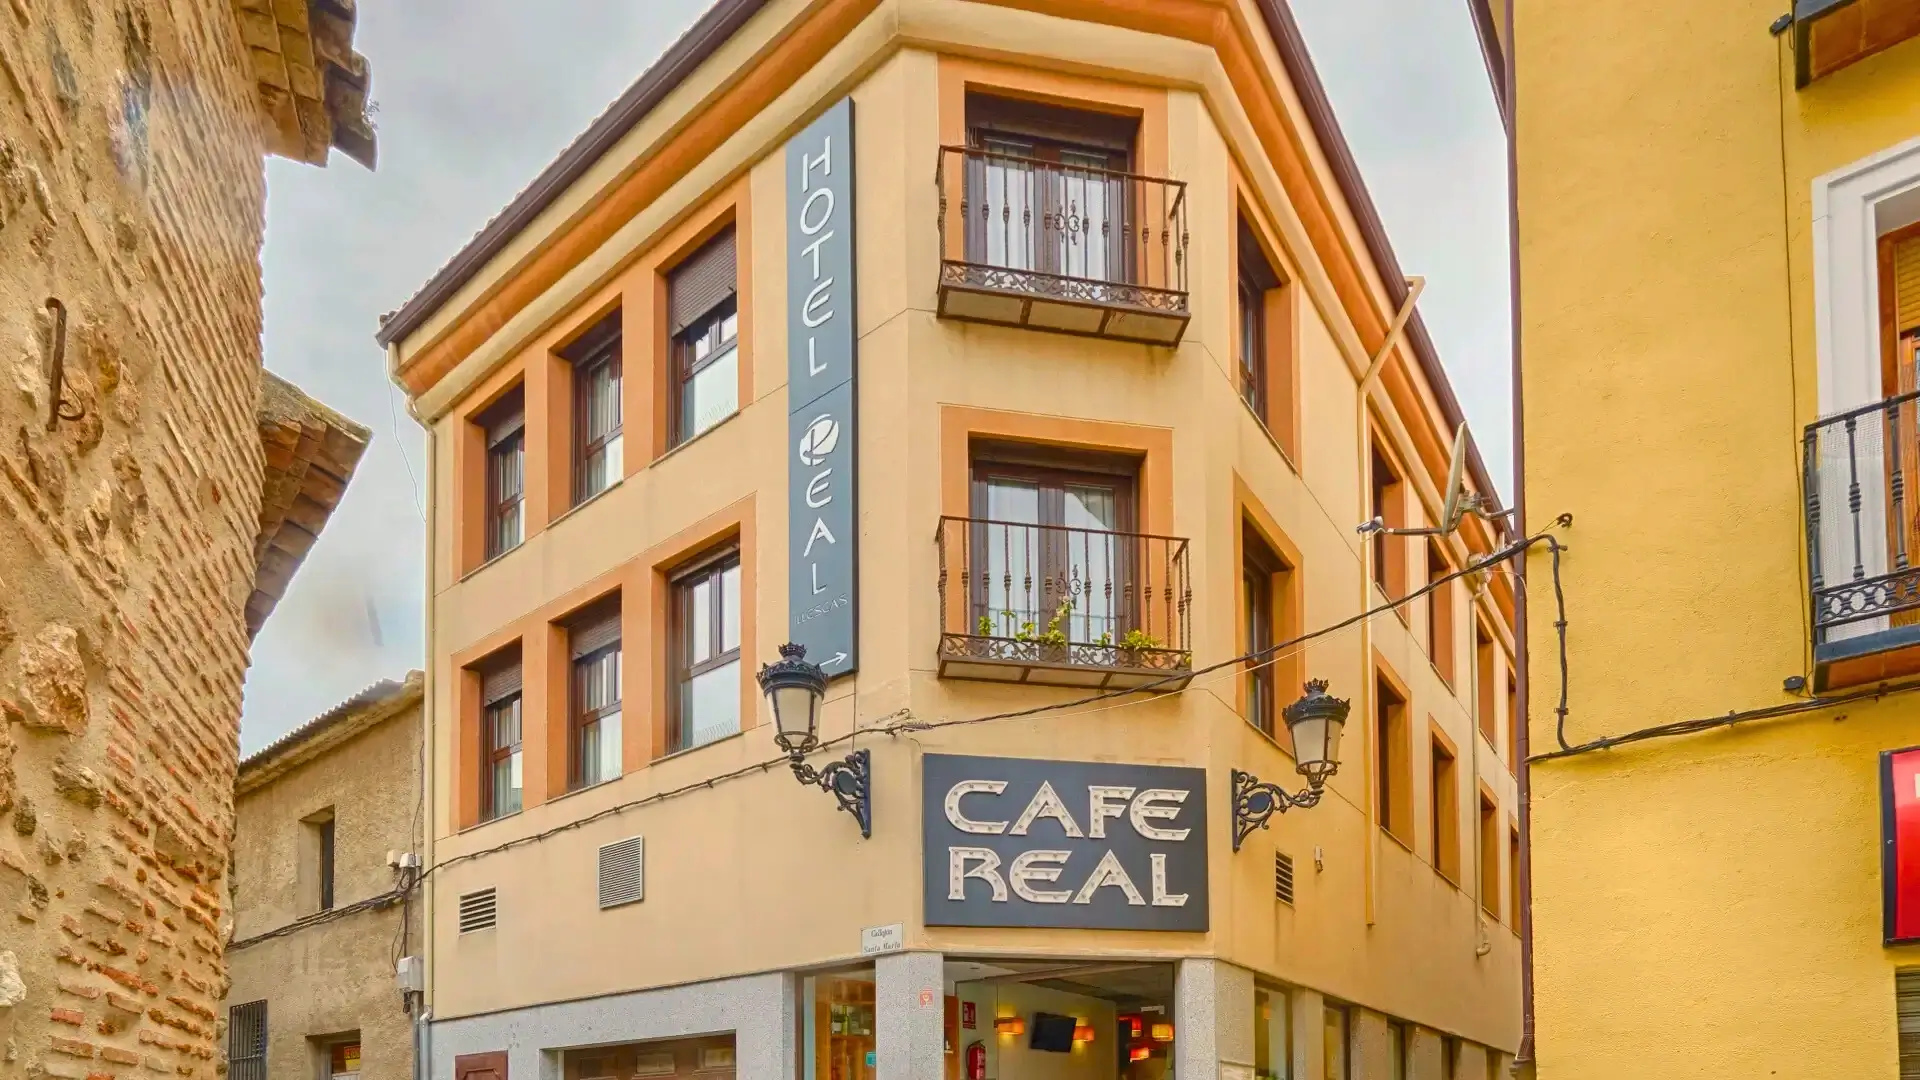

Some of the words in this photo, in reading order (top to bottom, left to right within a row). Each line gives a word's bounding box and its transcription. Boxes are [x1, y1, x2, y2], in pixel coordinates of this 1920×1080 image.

[799, 135, 836, 377] HOTEL
[799, 412, 840, 596] REAL
[944, 779, 1191, 841] CAFE
[948, 846, 1189, 907] REAL
[863, 945, 881, 954] Santa
